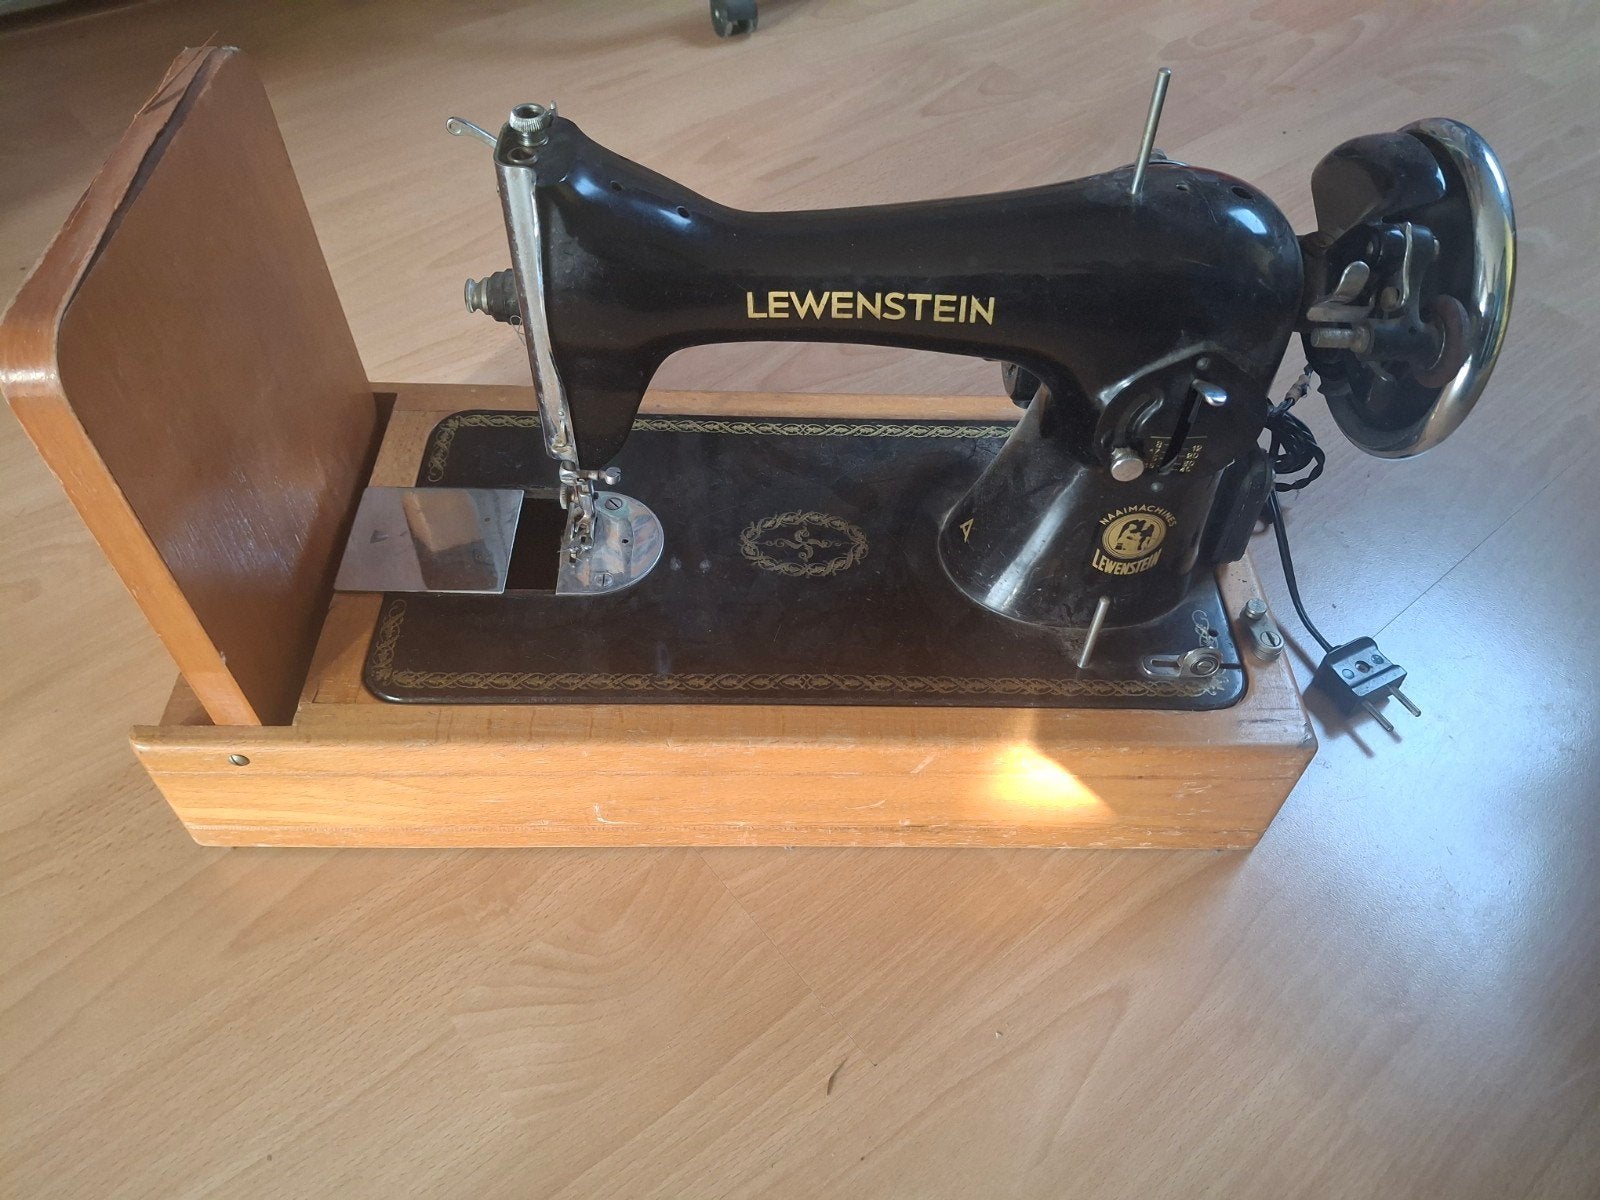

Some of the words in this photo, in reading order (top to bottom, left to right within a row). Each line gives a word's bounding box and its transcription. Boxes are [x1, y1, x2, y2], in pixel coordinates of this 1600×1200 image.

[746, 290, 995, 325] LEWENSTEIN
[1099, 504, 1177, 527] NAAIMACHINES
[1092, 548, 1162, 575] LEWENSTEIN
